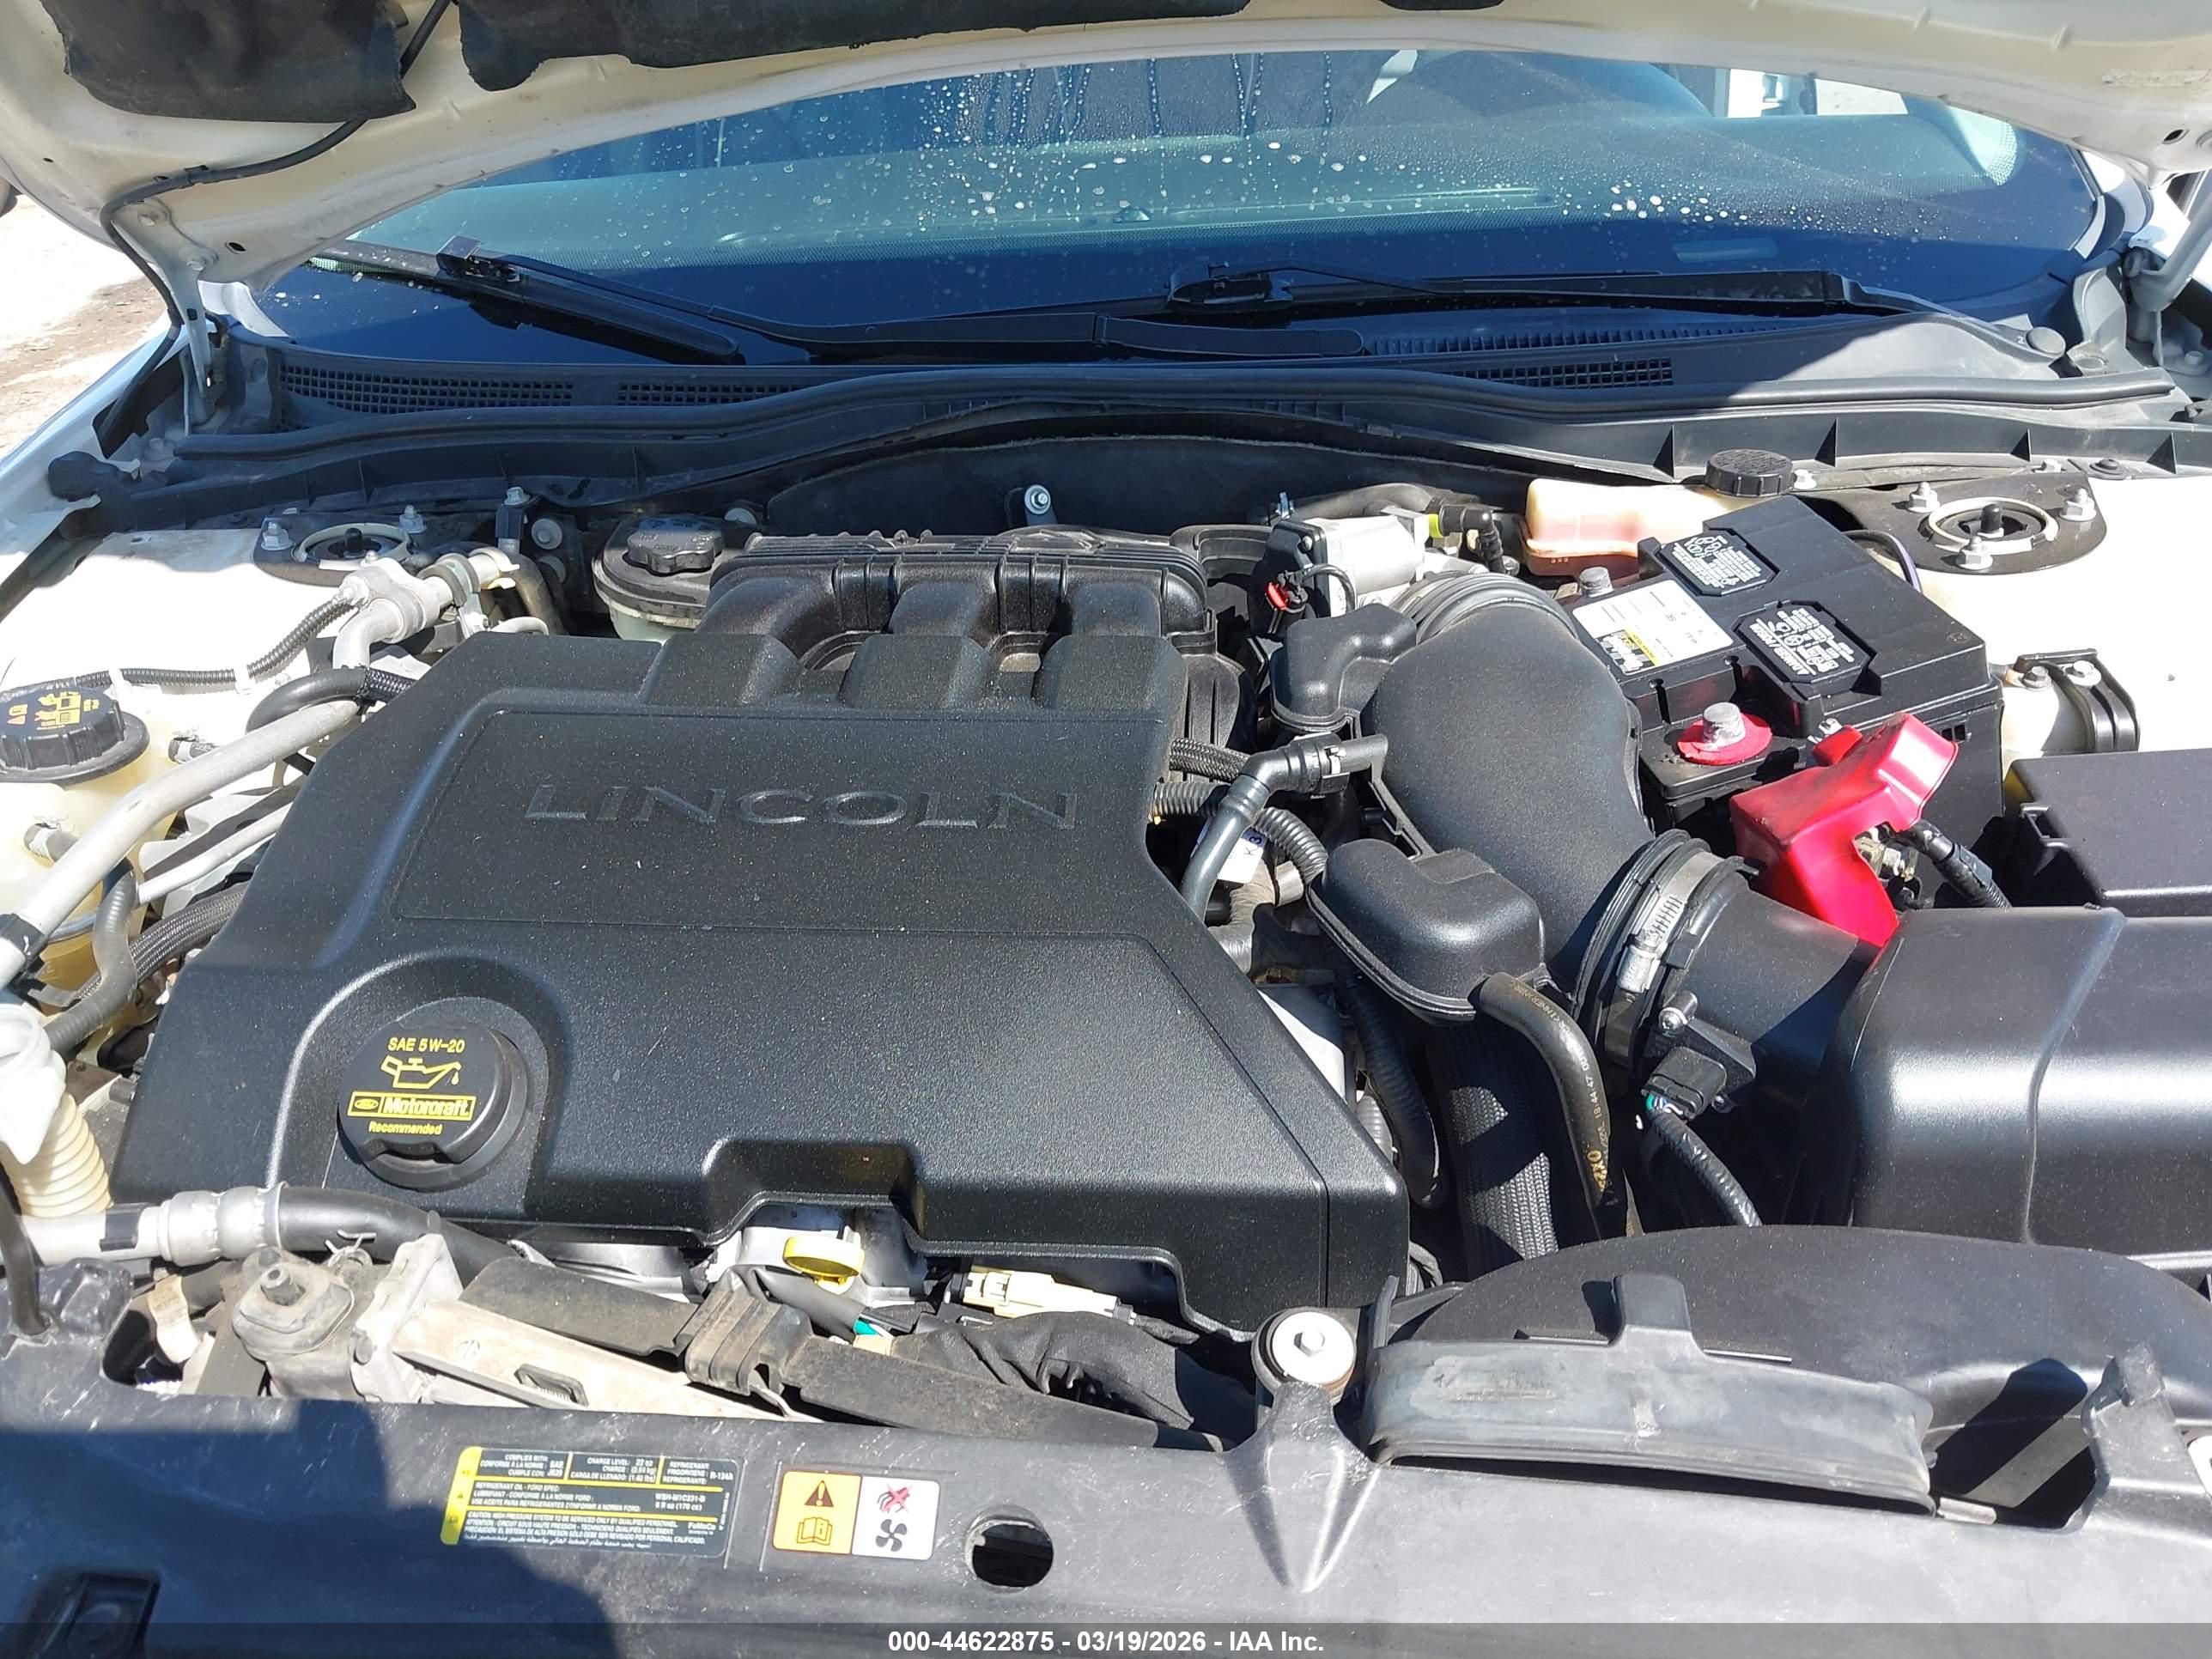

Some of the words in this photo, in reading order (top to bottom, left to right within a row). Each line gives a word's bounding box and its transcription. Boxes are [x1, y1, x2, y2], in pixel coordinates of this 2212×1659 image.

[524, 785, 1077, 830] LINCOLN
[387, 1036, 416, 1052] SAE
[418, 1038, 465, 1054] 5W-20
[383, 1097, 470, 1116] Motorcraft
[368, 1121, 443, 1135] Recommended
[709, 1471, 734, 1481] R-134A
[688, 1522, 716, 1530] FoMoCo
